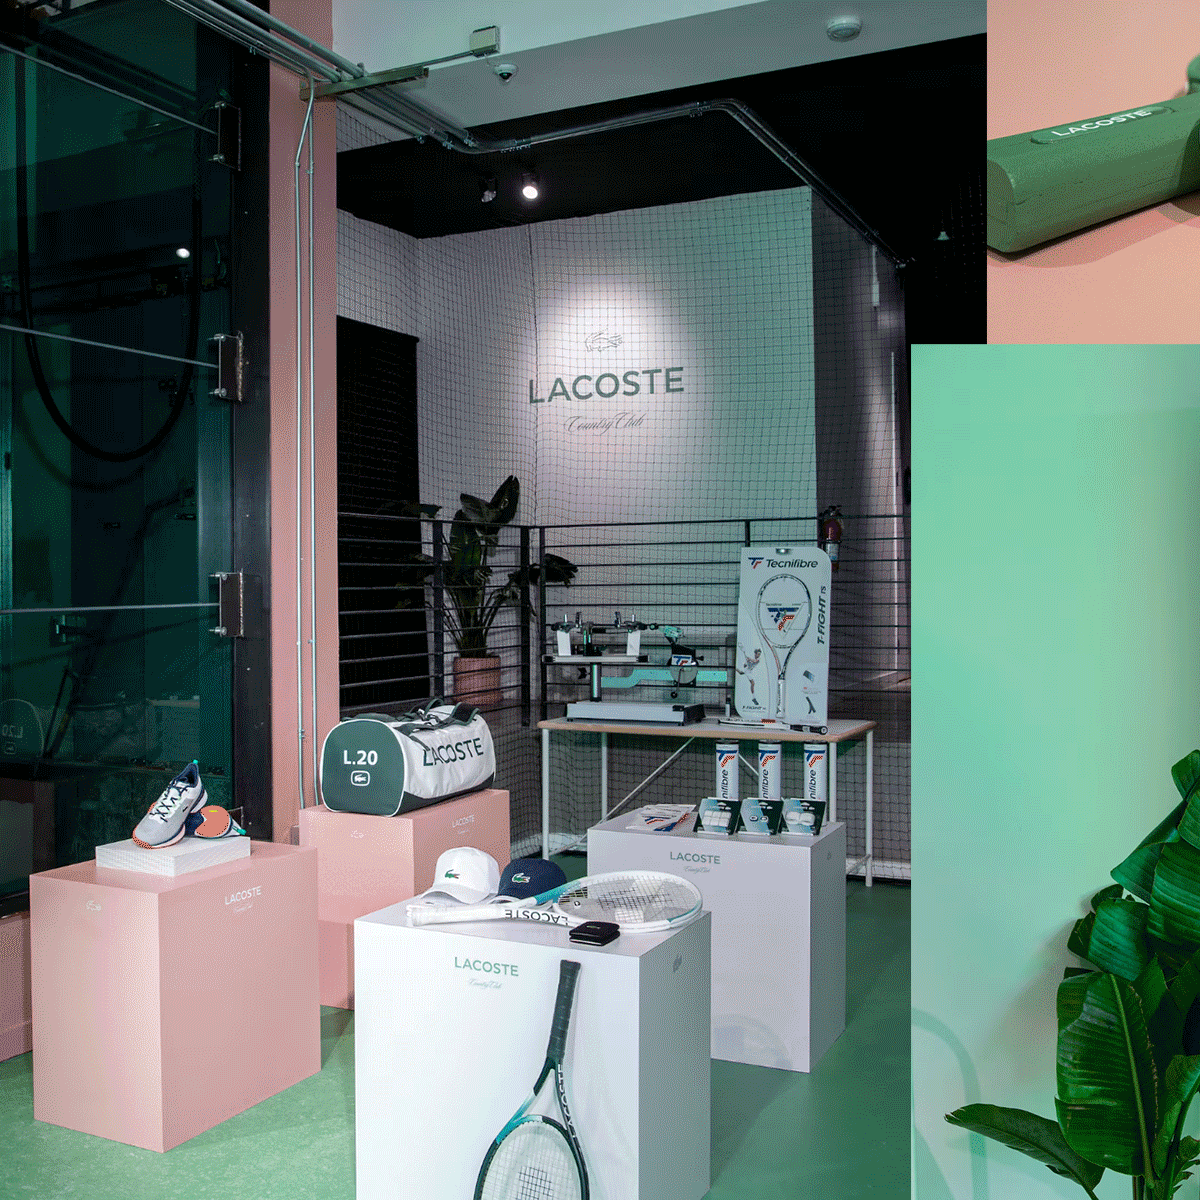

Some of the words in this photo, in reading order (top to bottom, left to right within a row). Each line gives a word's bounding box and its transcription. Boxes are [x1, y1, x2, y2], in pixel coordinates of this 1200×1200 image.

[1051, 108, 1152, 137] LACOSTE
[529, 367, 684, 404] LACOSTE
[564, 414, 614, 435] Country
[766, 558, 819, 569] Tecnifibre
[343, 749, 378, 766] L.20
[423, 737, 484, 767] LACOSTE
[721, 769, 729, 800] nifibre
[670, 851, 721, 864] LACOSTE
[225, 886, 262, 905] LACOSTE
[454, 956, 519, 977] LACOSTE
